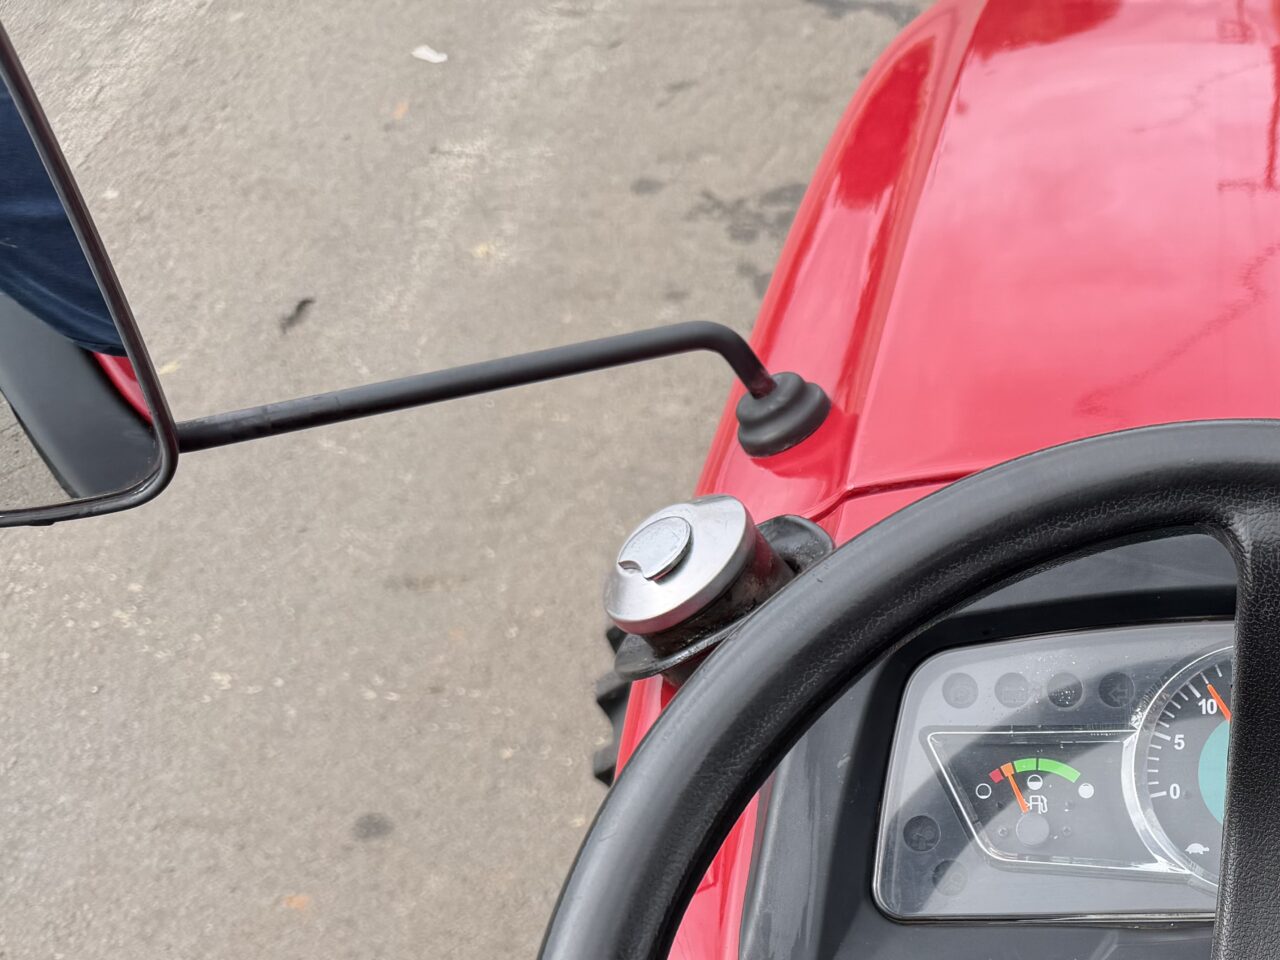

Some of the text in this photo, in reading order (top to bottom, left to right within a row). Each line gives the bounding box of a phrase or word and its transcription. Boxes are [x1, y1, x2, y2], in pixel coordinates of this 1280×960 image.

[1198, 698, 1218, 715] 10
[1173, 734, 1185, 750] 5
[1169, 783, 1181, 799] 0
